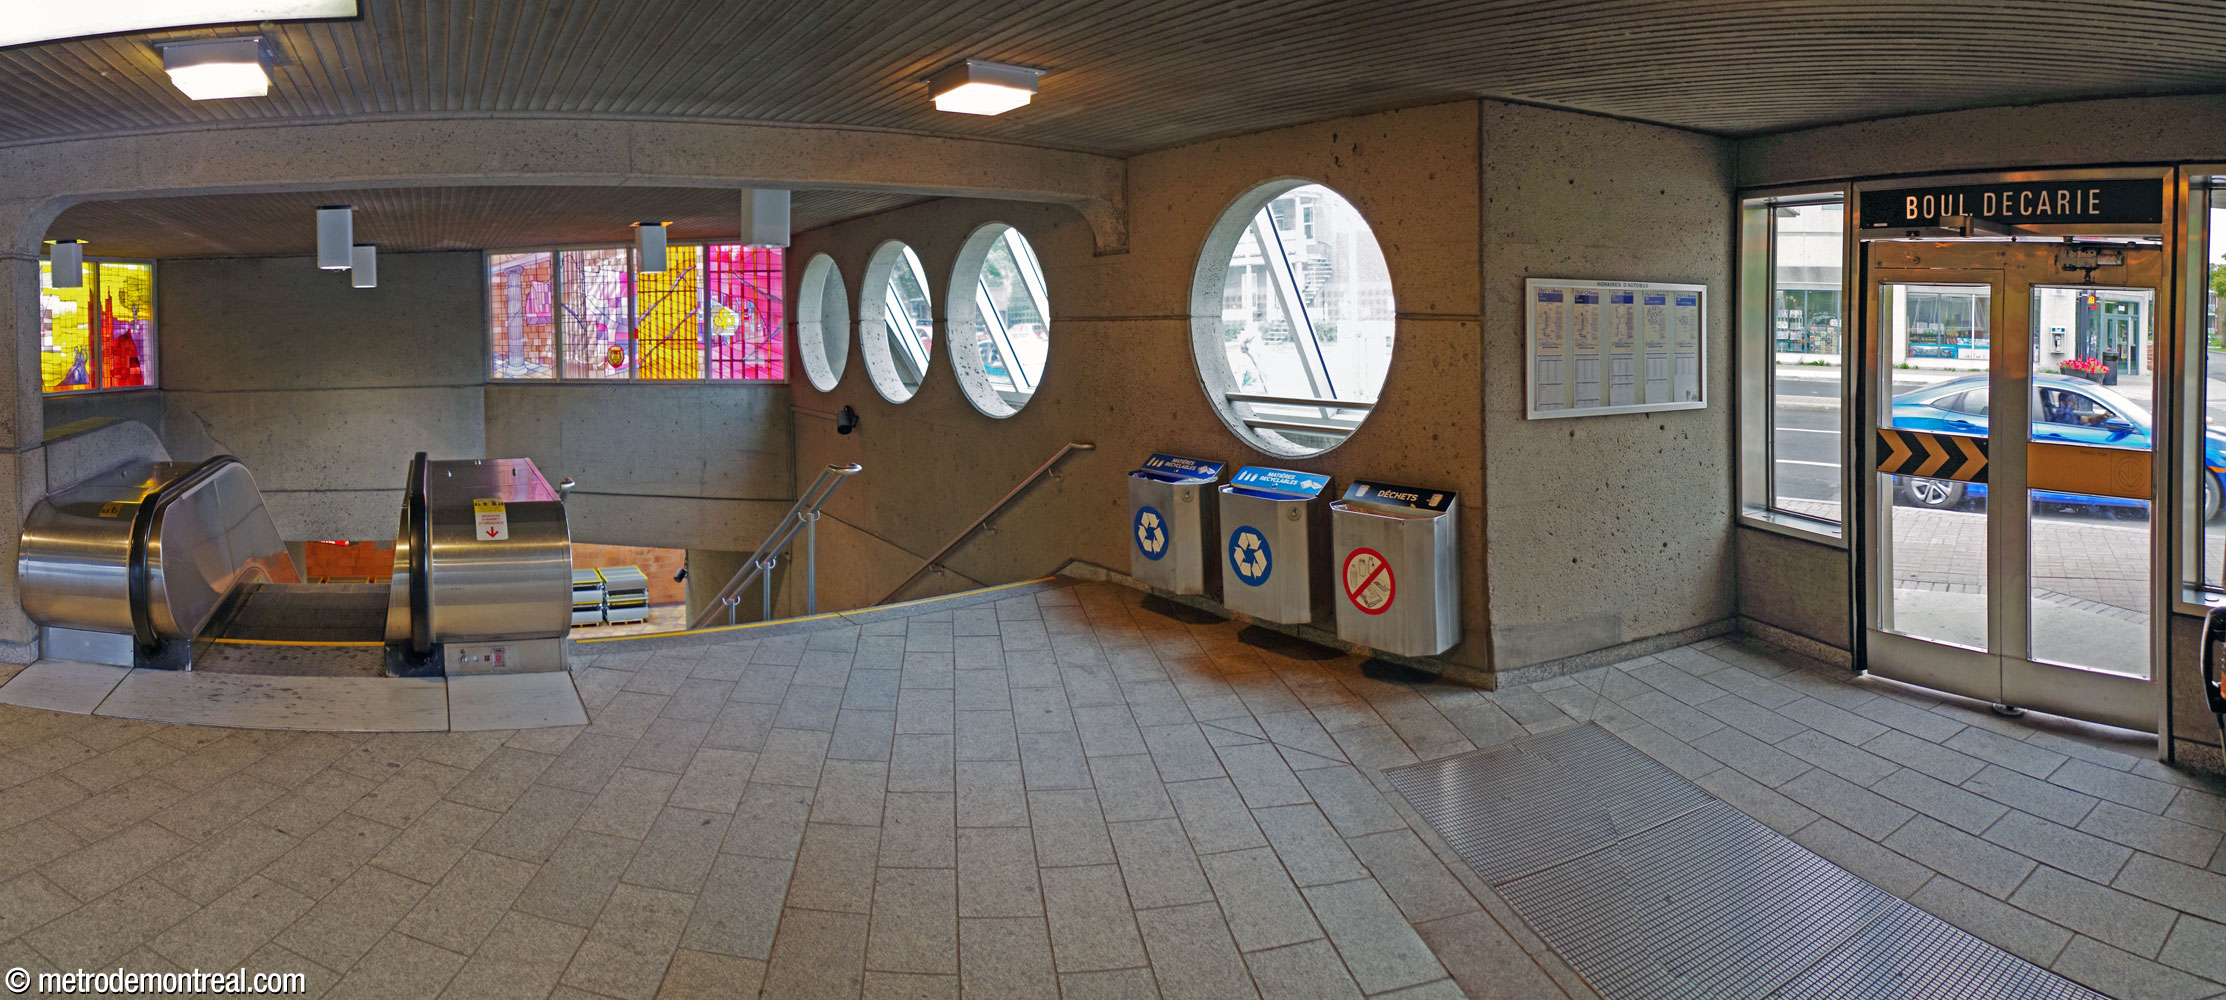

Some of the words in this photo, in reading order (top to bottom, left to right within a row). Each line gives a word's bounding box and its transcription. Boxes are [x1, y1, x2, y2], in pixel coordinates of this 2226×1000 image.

[1983, 189, 2101, 217] DECARIE
[1172, 457, 1196, 465] MATIÈRES
[1164, 462, 1197, 471] RECYCLABLES
[1259, 475, 1299, 486] RECYCLABLES
[1267, 471, 1296, 480] MATIÈRES
[1377, 489, 1419, 502] DÉCHETS
